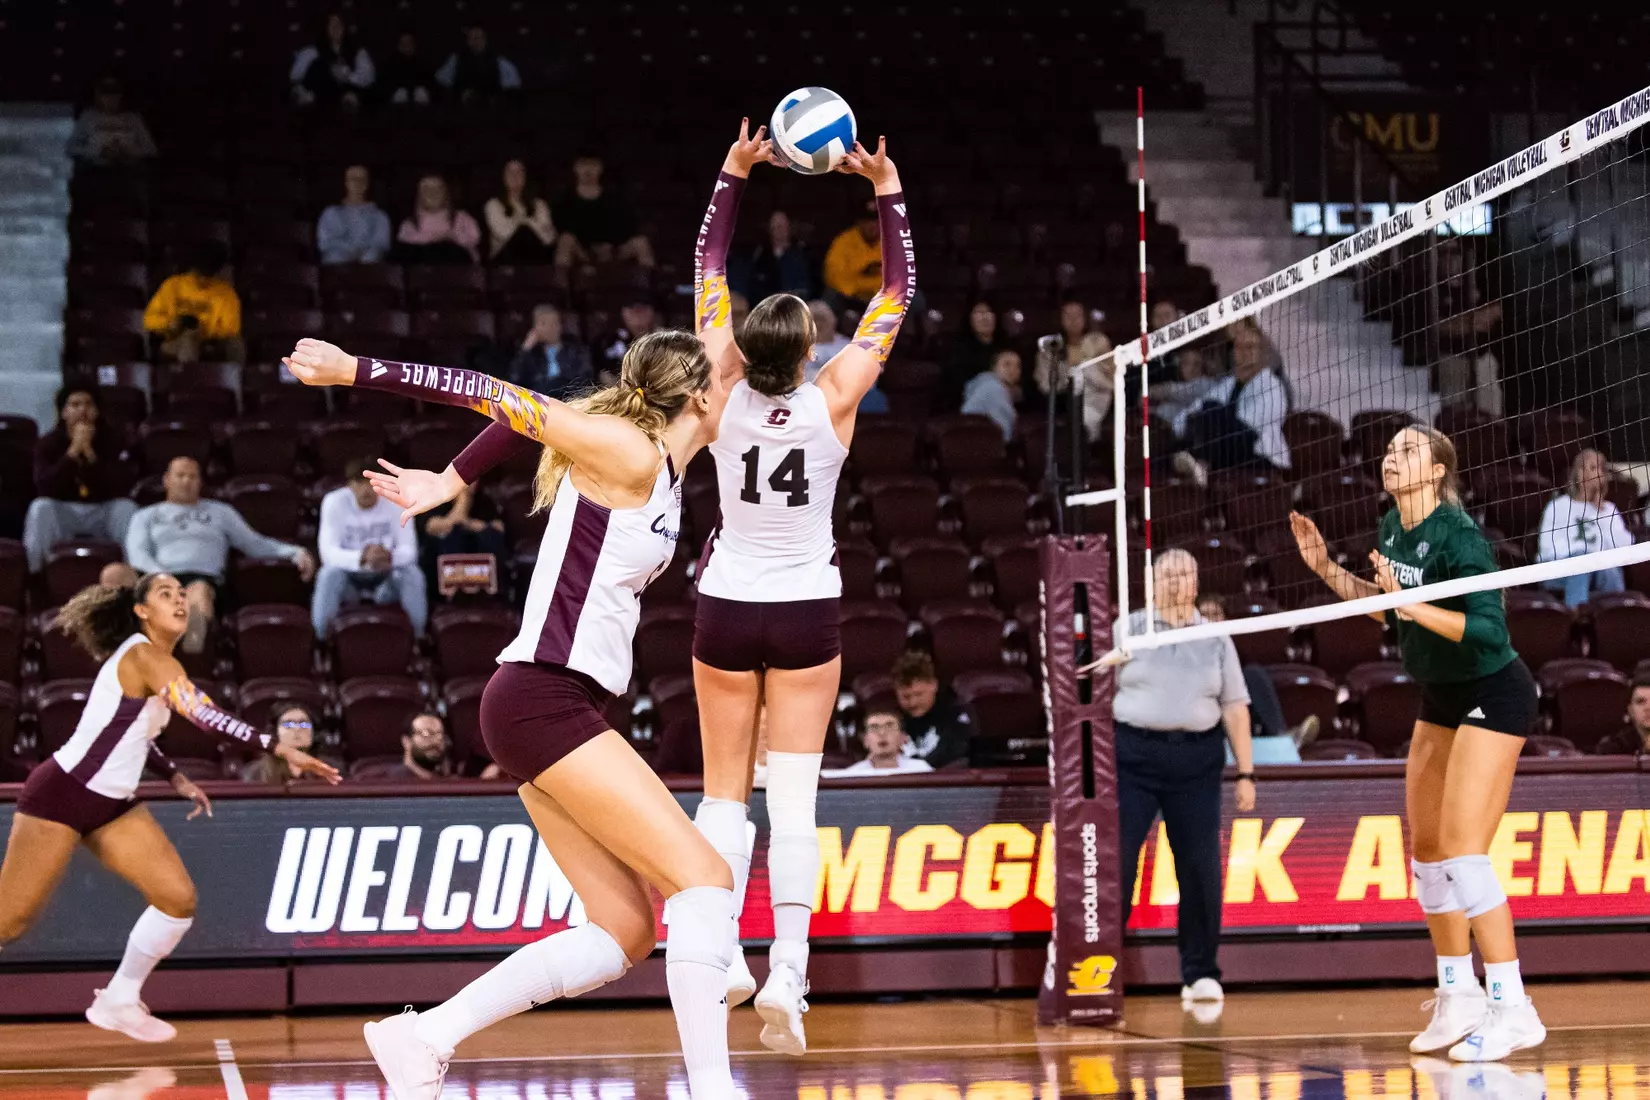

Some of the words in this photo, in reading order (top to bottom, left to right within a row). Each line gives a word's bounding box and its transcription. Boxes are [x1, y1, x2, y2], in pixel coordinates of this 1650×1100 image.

[1331, 112, 1439, 150] CMU
[1585, 107, 1619, 142] CENTRAL
[1444, 180, 1472, 212] CENTRAL
[1473, 163, 1506, 198] MICHIGAN
[1506, 140, 1548, 181] VOLLEYBALL
[1380, 209, 1414, 243] VOLLEYBALL
[400, 363, 505, 403] CHIPPEWAS
[740, 445, 810, 507] 14
[1080, 823, 1099, 877] sports
[1336, 809, 1650, 901] AENA
[265, 823, 590, 933] WELCOM
